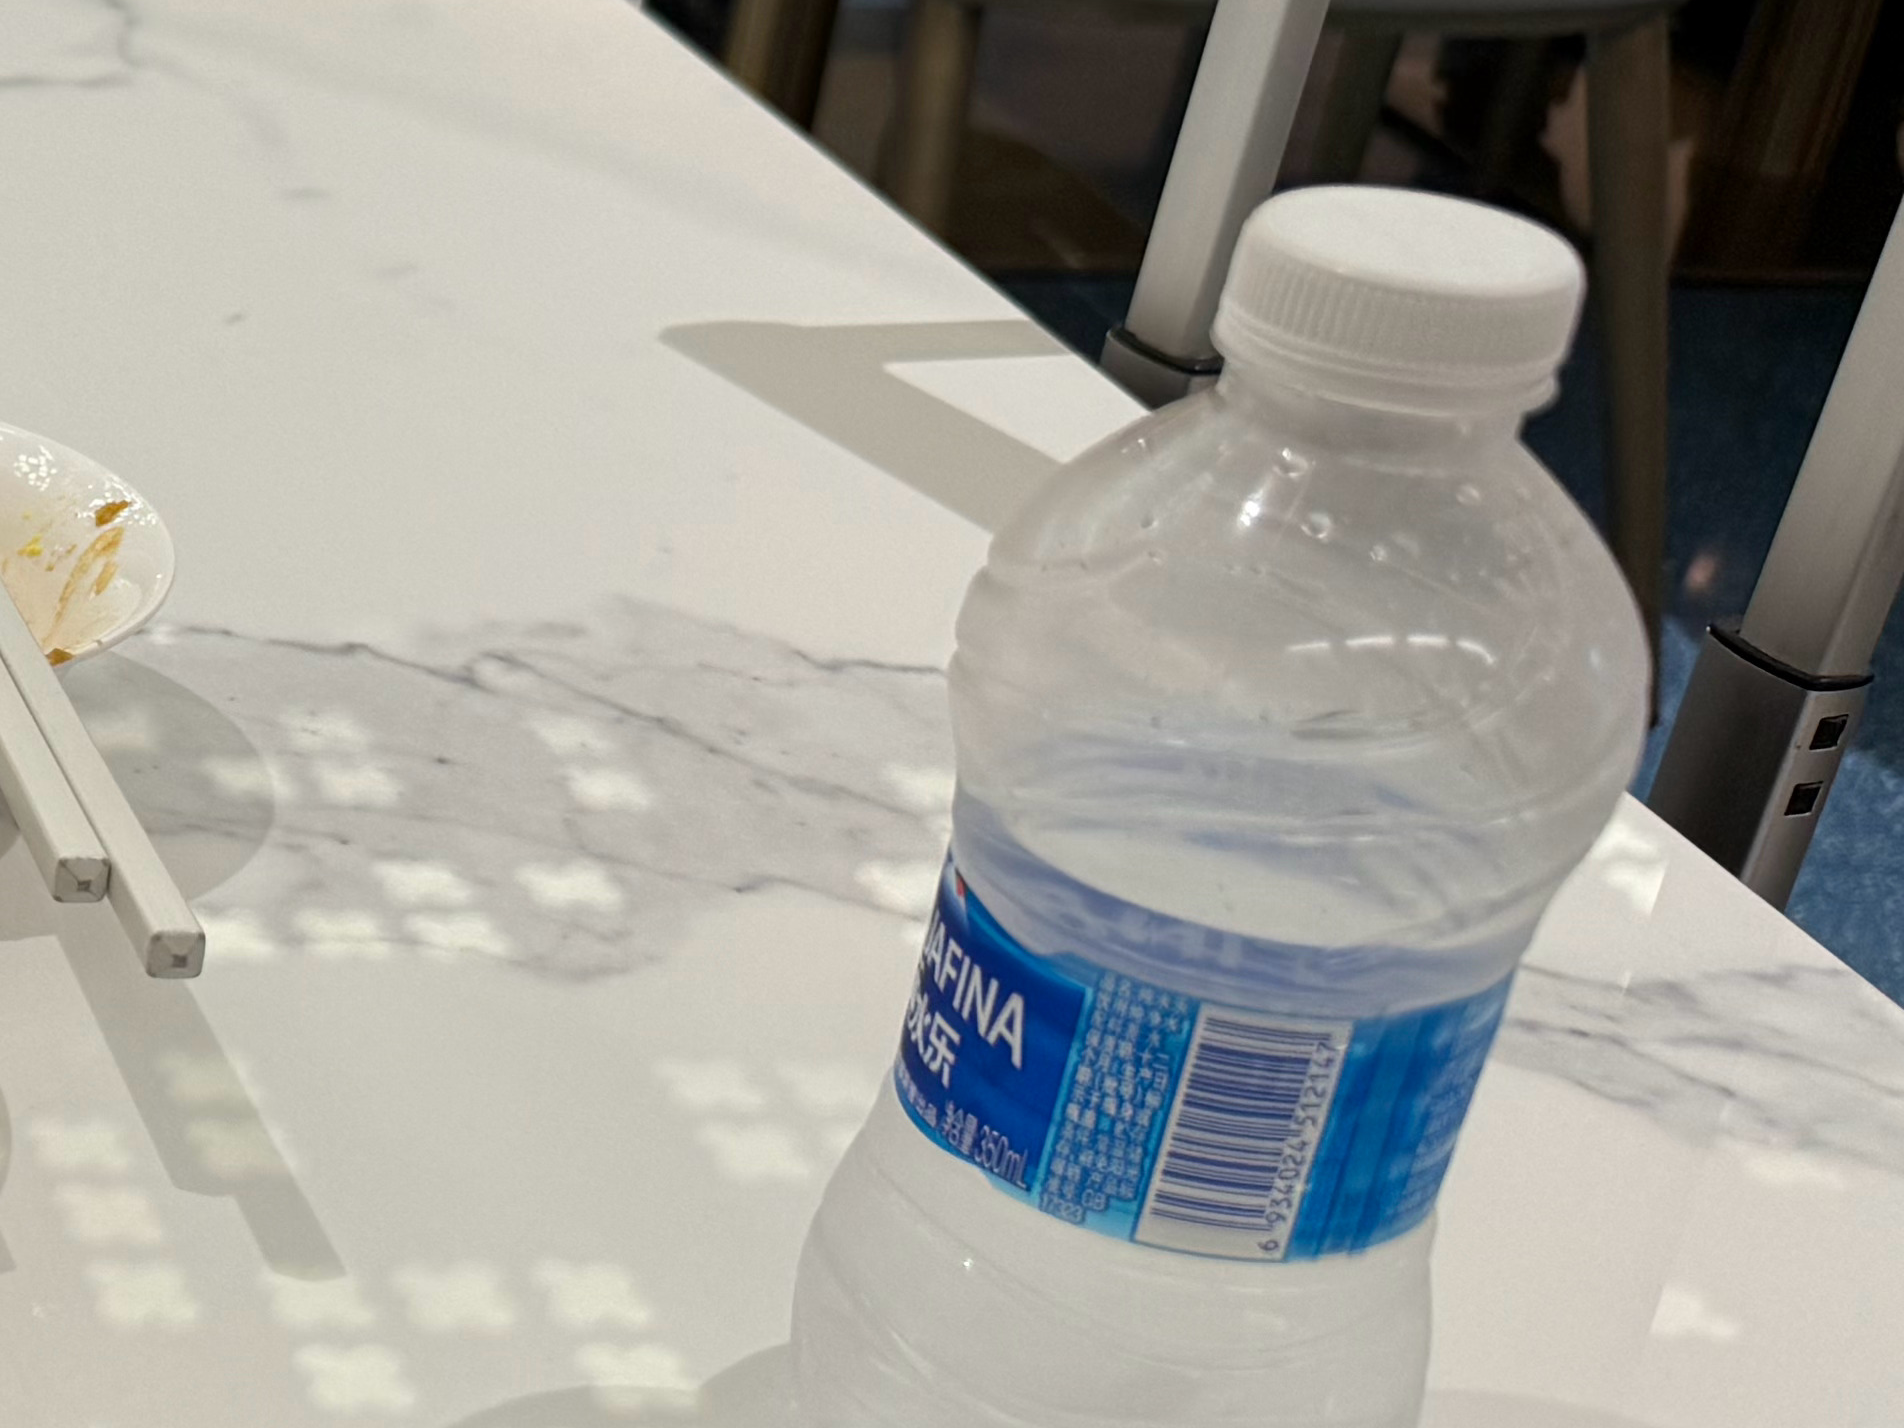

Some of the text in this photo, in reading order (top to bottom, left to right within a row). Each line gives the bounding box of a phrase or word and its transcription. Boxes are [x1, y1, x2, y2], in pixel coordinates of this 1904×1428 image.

[907, 966, 961, 1089] 水乐
[974, 1124, 1028, 1188] 350mL
[1257, 1041, 1338, 1252] 6 934024 512147
